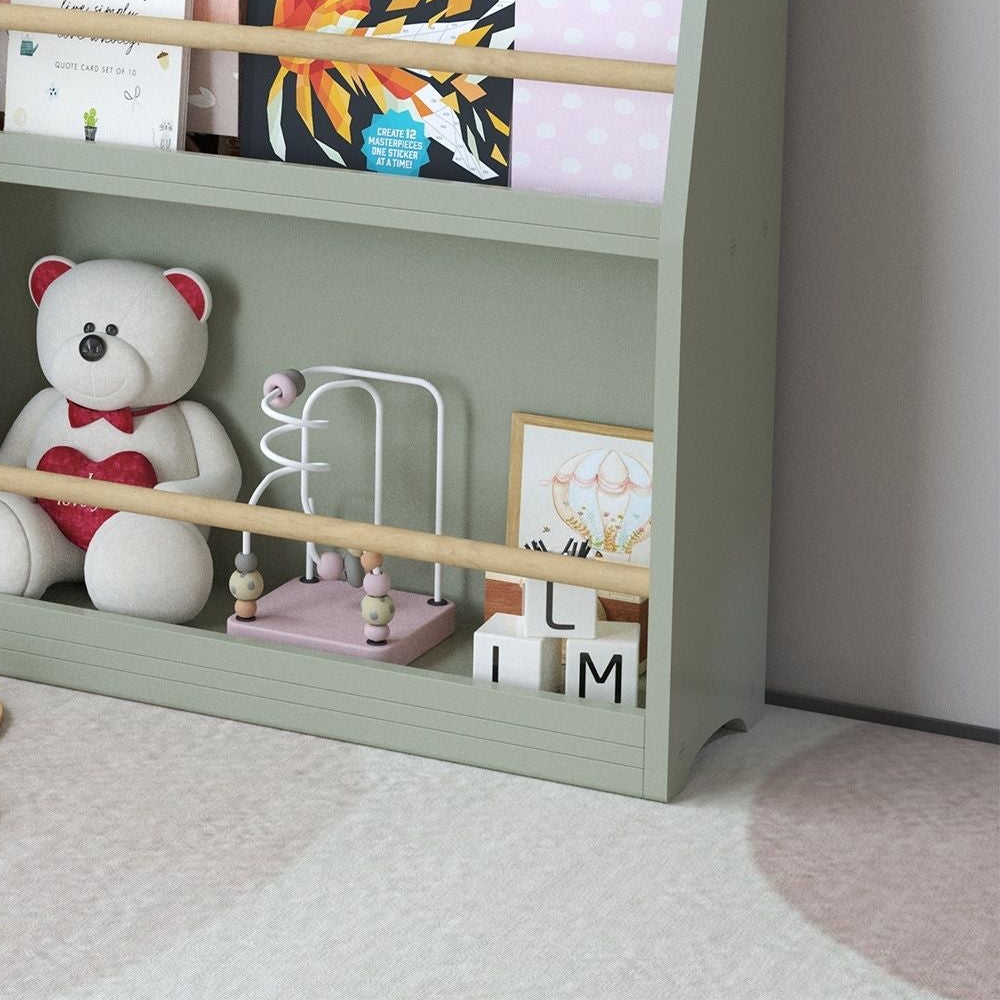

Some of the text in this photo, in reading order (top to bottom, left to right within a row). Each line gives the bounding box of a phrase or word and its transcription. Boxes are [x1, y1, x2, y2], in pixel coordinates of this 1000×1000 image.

[54, 60, 137, 76] QUOTE CARD SET OF 10
[377, 127, 417, 140] CREATE 12
[368, 137, 423, 150] MASTERPIECES
[372, 147, 418, 160] ONE STICKER
[376, 158, 413, 169] AT A TIME!
[546, 581, 576, 630] L
[578, 652, 623, 704] M
